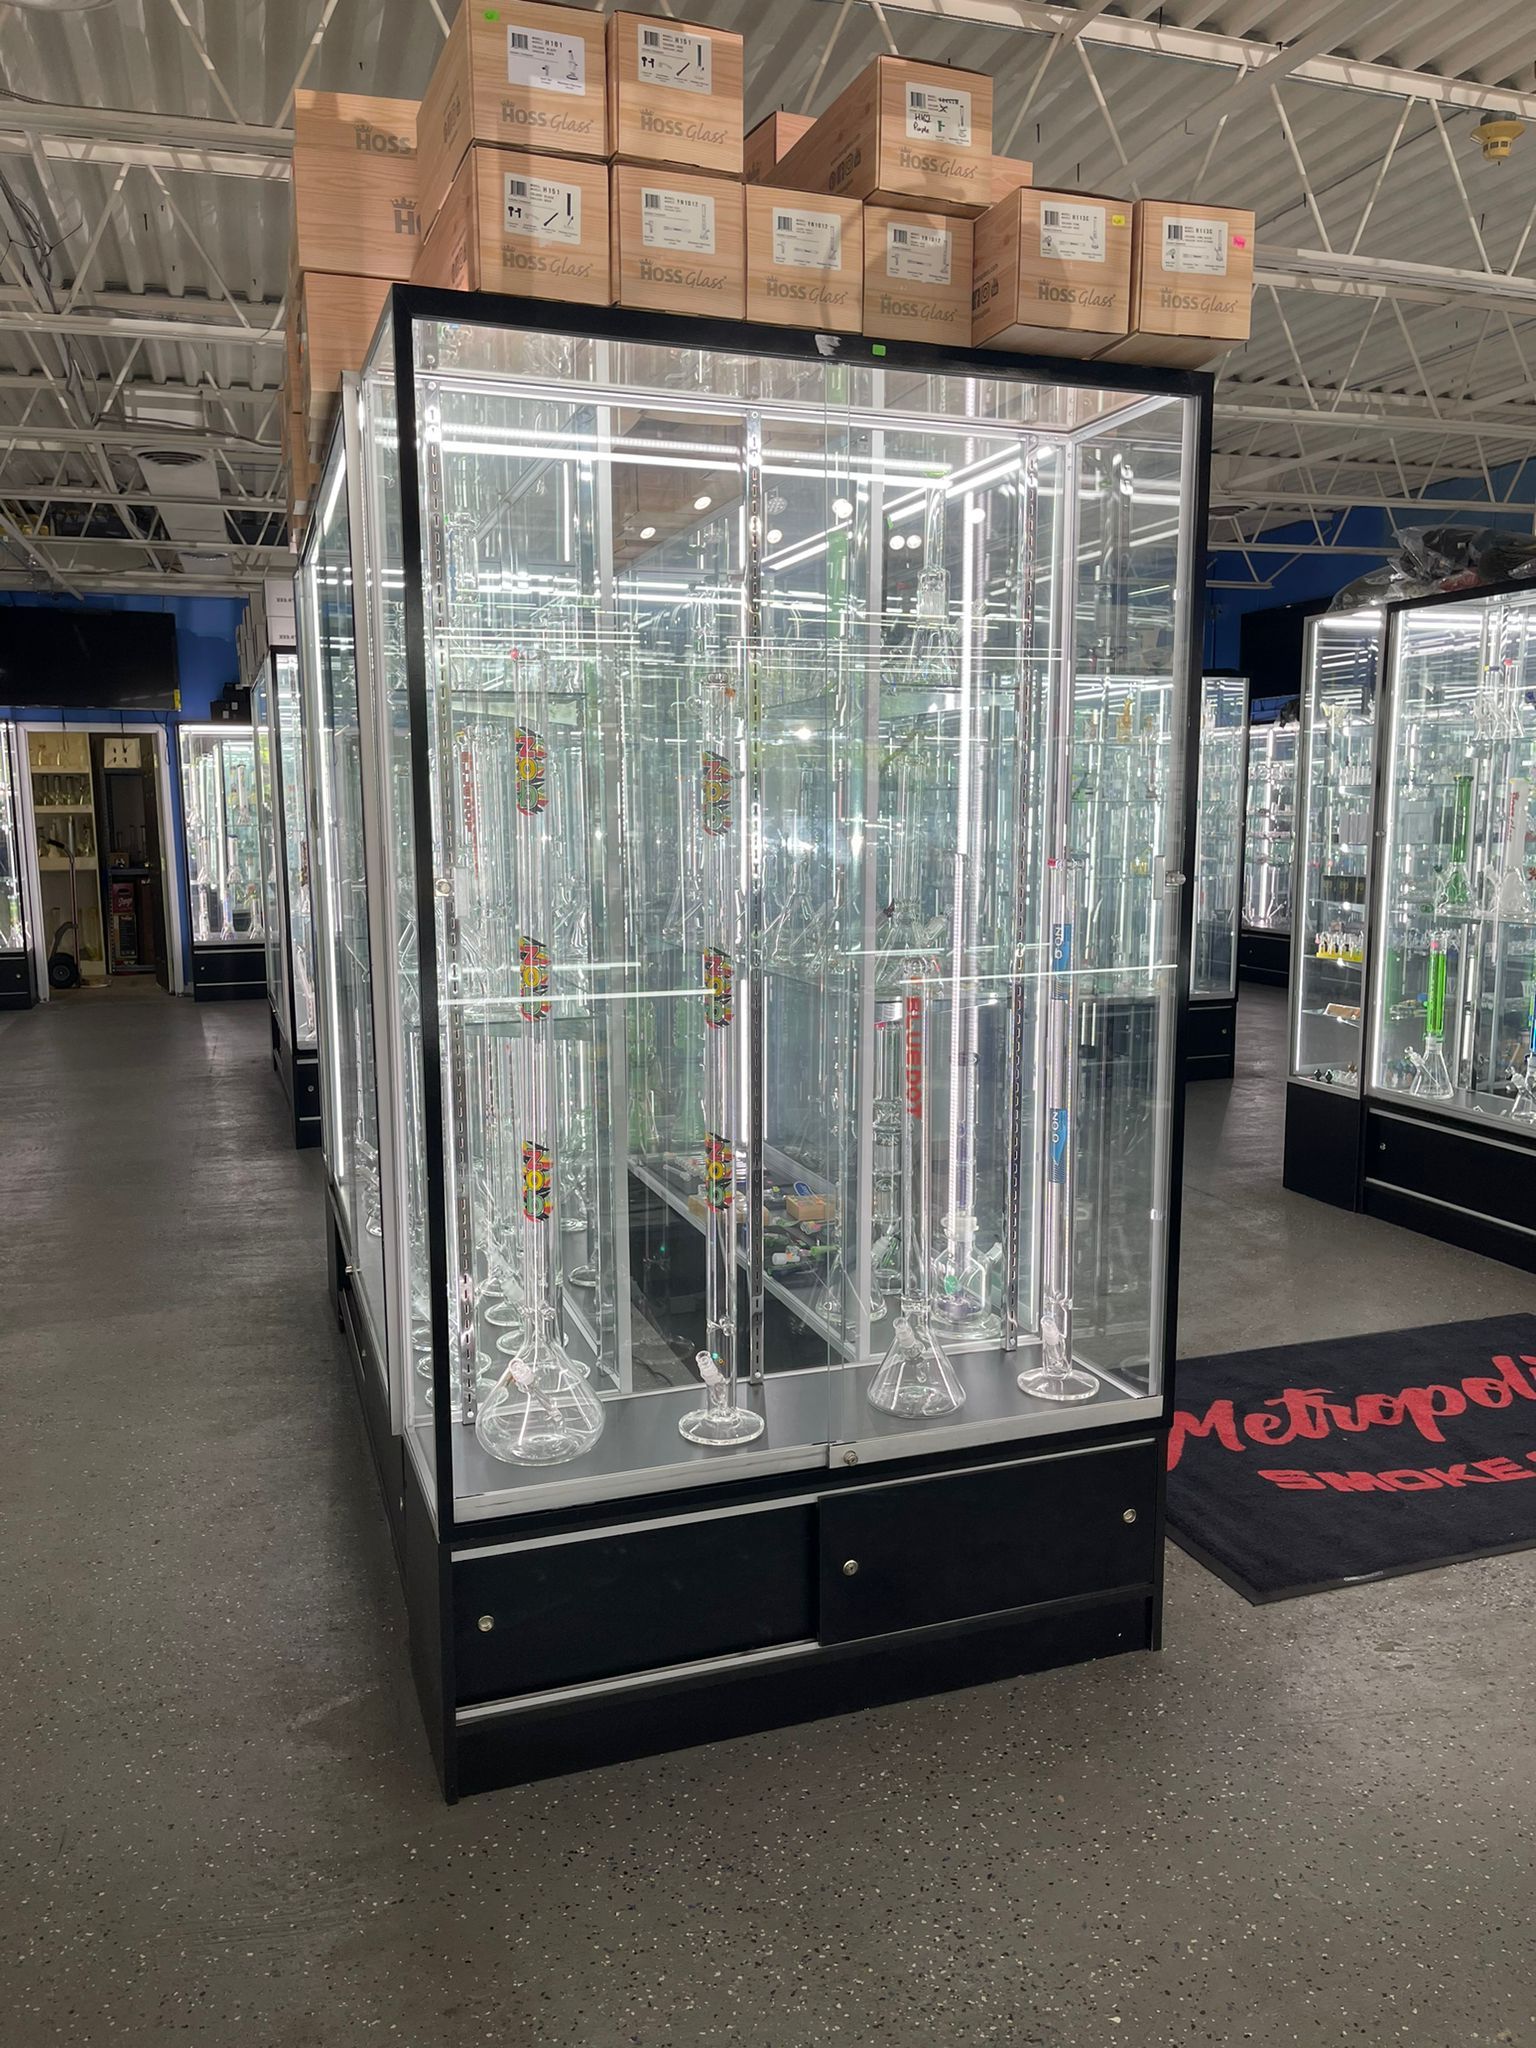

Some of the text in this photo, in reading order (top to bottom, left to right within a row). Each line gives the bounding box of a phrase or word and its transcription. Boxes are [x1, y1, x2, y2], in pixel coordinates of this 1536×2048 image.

[502, 107, 547, 127] HOSS
[641, 115, 683, 136] HOSS
[355, 132, 411, 155] HOSS
[900, 152, 938, 172] HOSS
[502, 252, 547, 271] HOSS
[640, 265, 682, 284] HOSS
[766, 282, 806, 299] HOSS
[1038, 286, 1075, 303] HOSS
[881, 299, 918, 317] HOSS
[1161, 295, 1198, 310] HOSS
[1257, 1456, 1536, 1492] SMOKE
